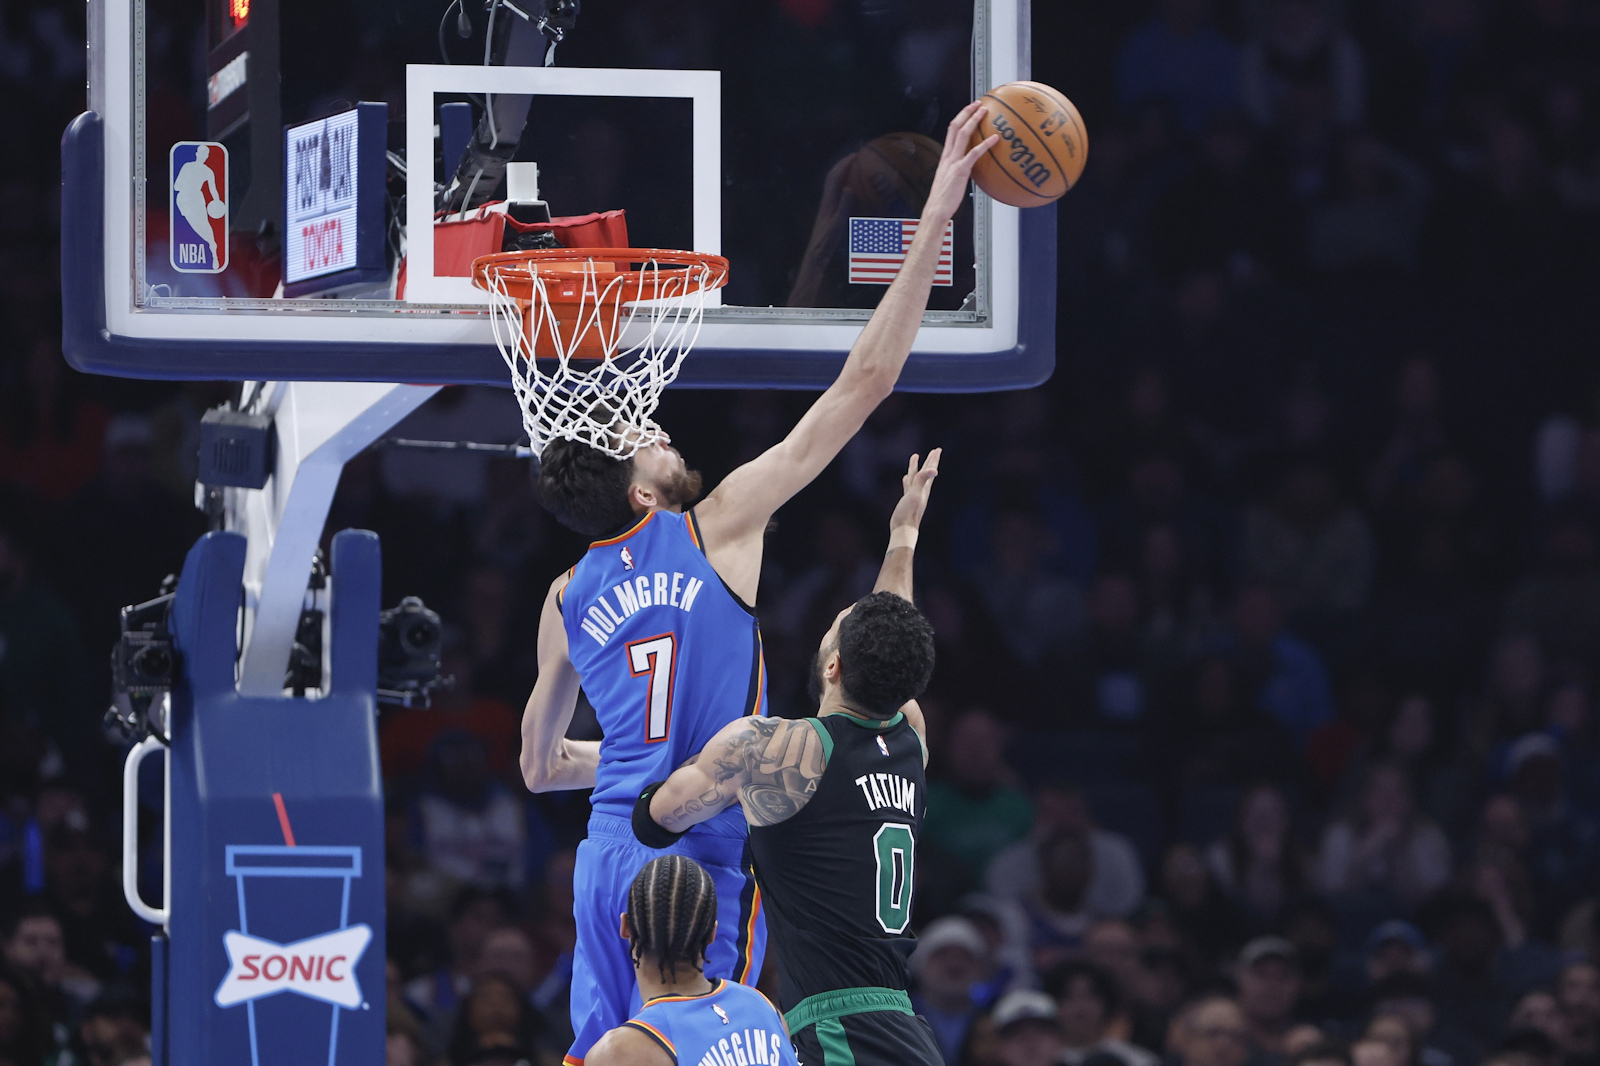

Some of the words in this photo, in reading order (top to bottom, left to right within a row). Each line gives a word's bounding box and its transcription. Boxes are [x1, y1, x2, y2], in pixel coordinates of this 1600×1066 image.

[296, 134, 319, 213] POST
[333, 125, 353, 202] OAK
[992, 113, 1051, 188] Wilson
[179, 243, 207, 264] NBA
[303, 218, 344, 272] TOYOTA
[580, 572, 704, 647] HOLMGREN
[624, 631, 677, 744] 7
[855, 773, 916, 817] TATUM
[873, 822, 915, 935] 0
[236, 954, 347, 982] SONIC
